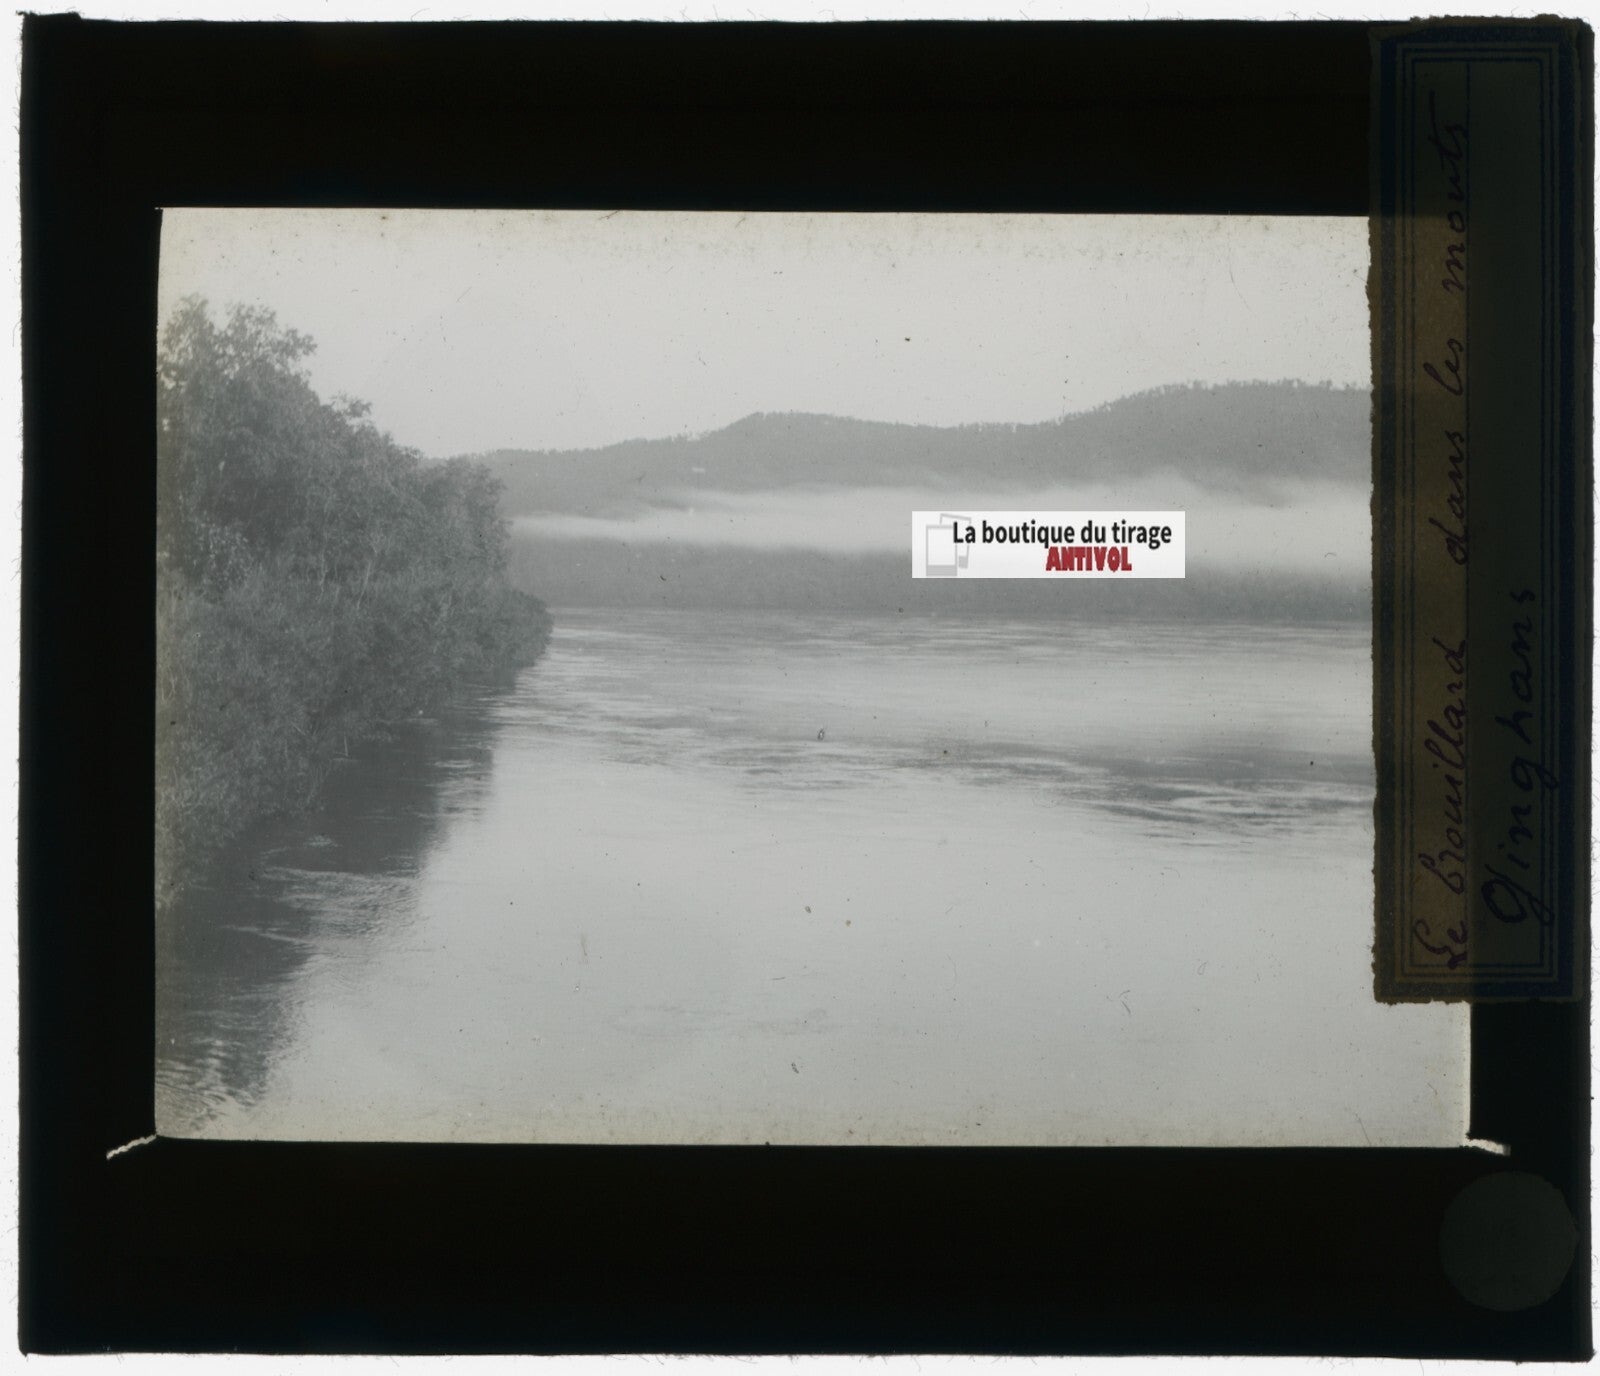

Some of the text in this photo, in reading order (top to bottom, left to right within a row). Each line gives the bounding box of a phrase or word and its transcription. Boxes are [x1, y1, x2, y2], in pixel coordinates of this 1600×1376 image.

[1424, 338, 1465, 397] les
[1428, 430, 1470, 566] dans
[1418, 636, 1467, 895] brouillard
[1412, 919, 1468, 970] Le
